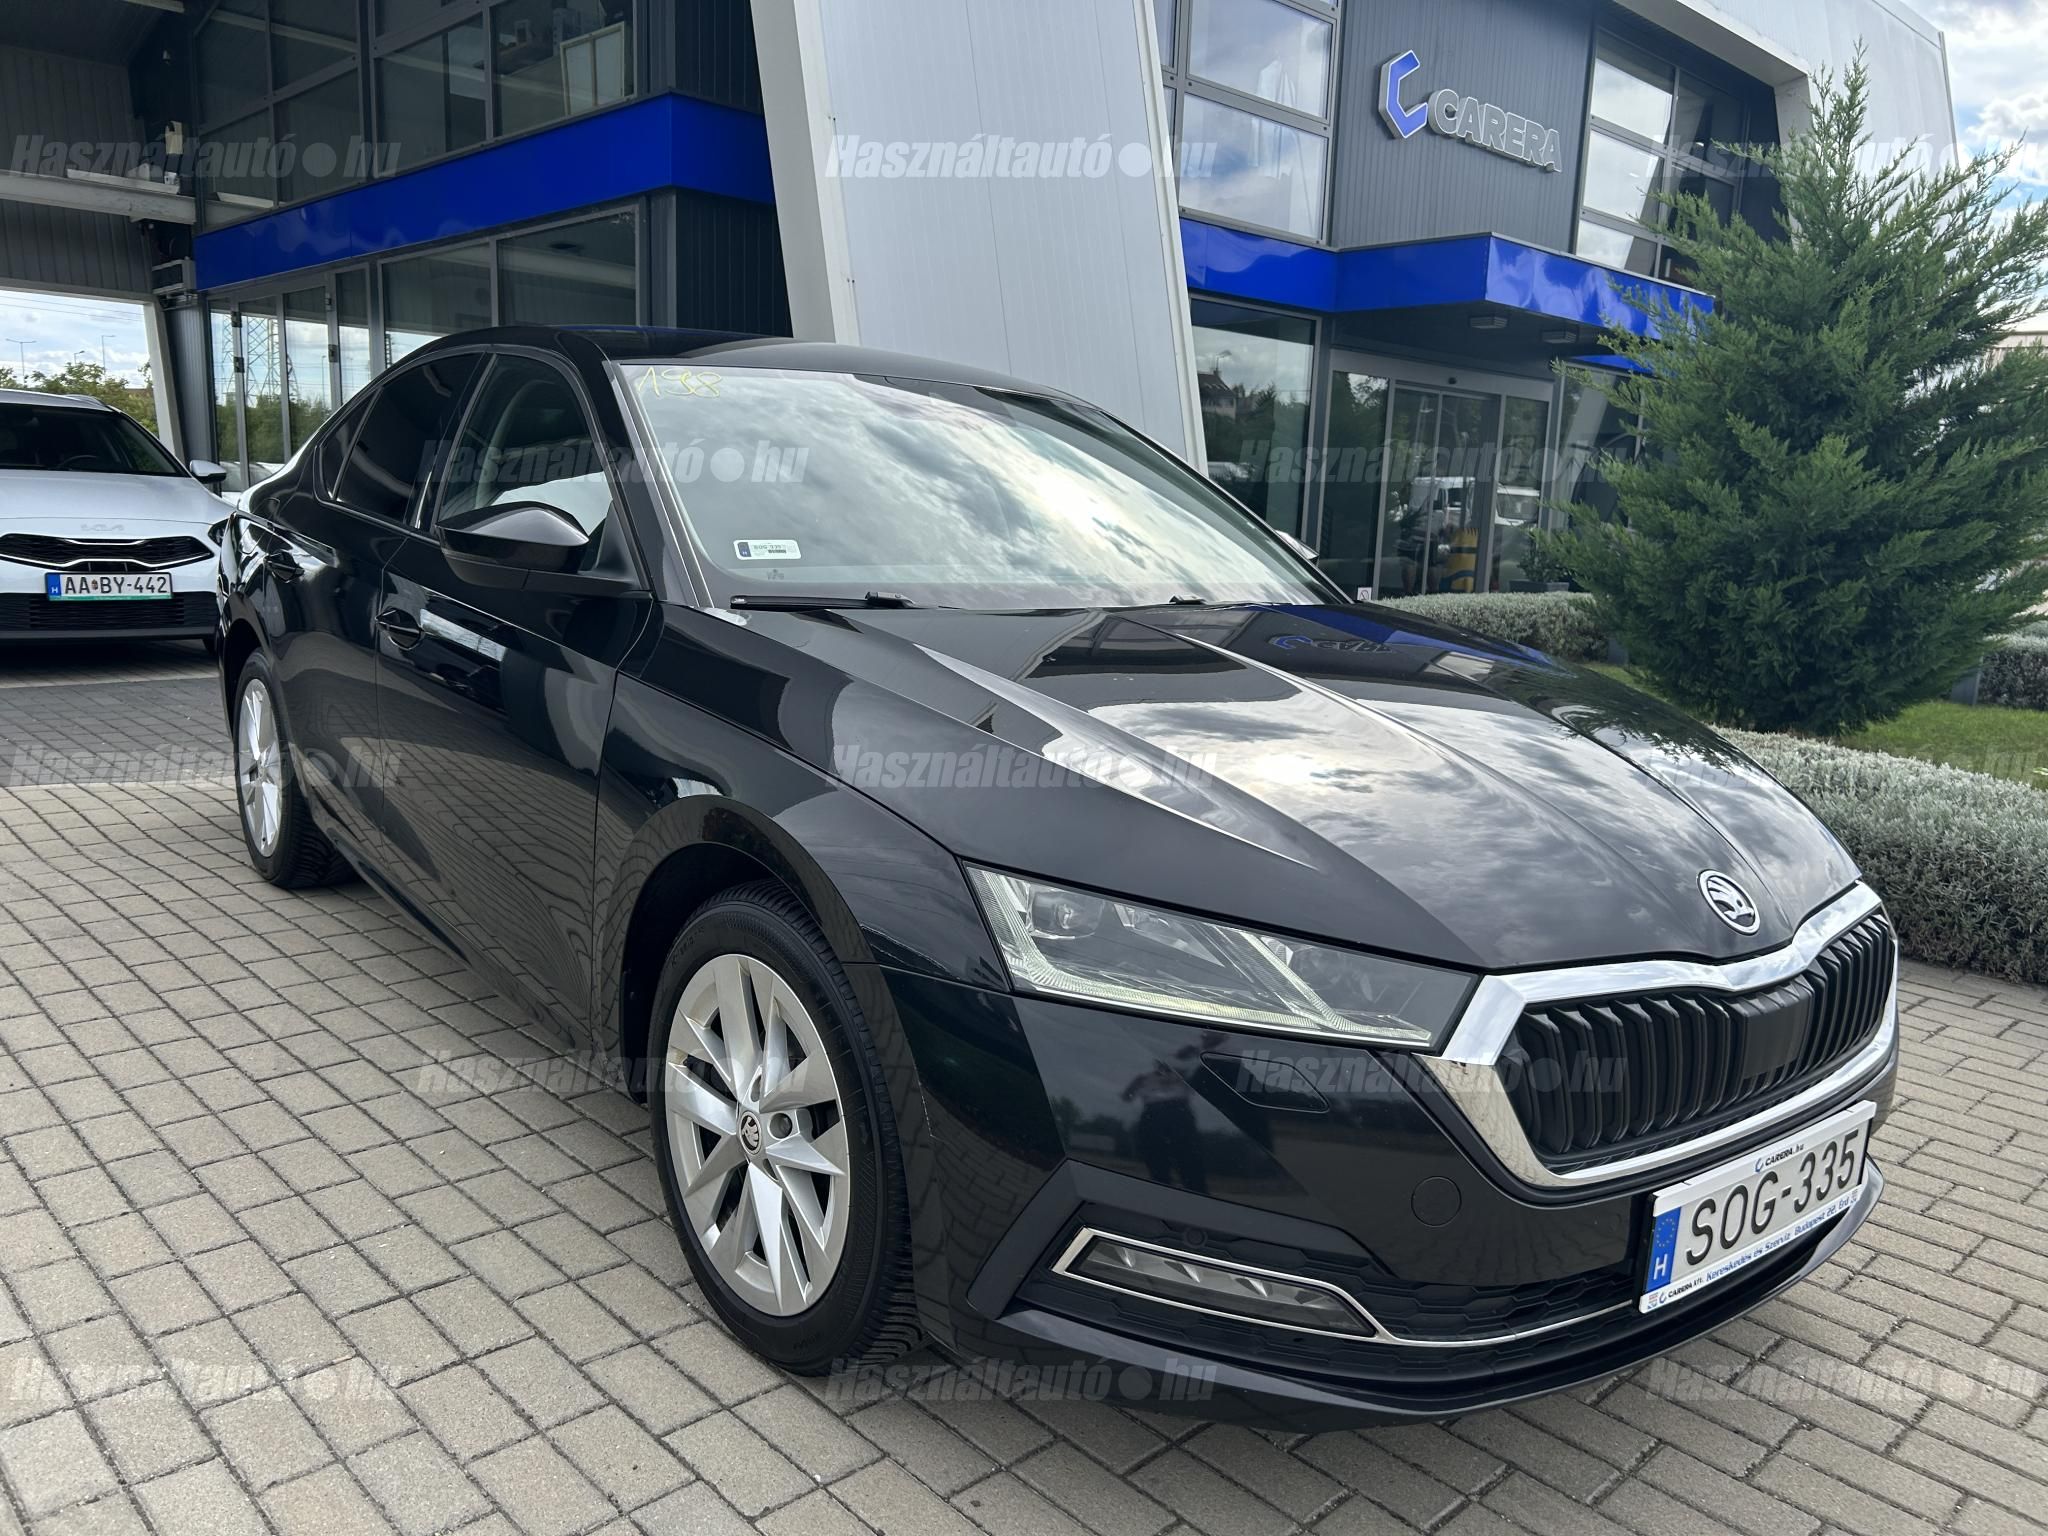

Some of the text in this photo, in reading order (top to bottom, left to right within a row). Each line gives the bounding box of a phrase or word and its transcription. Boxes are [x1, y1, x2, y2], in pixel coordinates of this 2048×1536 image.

[1428, 89, 1562, 173] CARERA
[1686, 1129, 1859, 1266] SOG-335
[1794, 1212, 1825, 1235] Budapest
[1653, 1253, 1668, 1280] H
